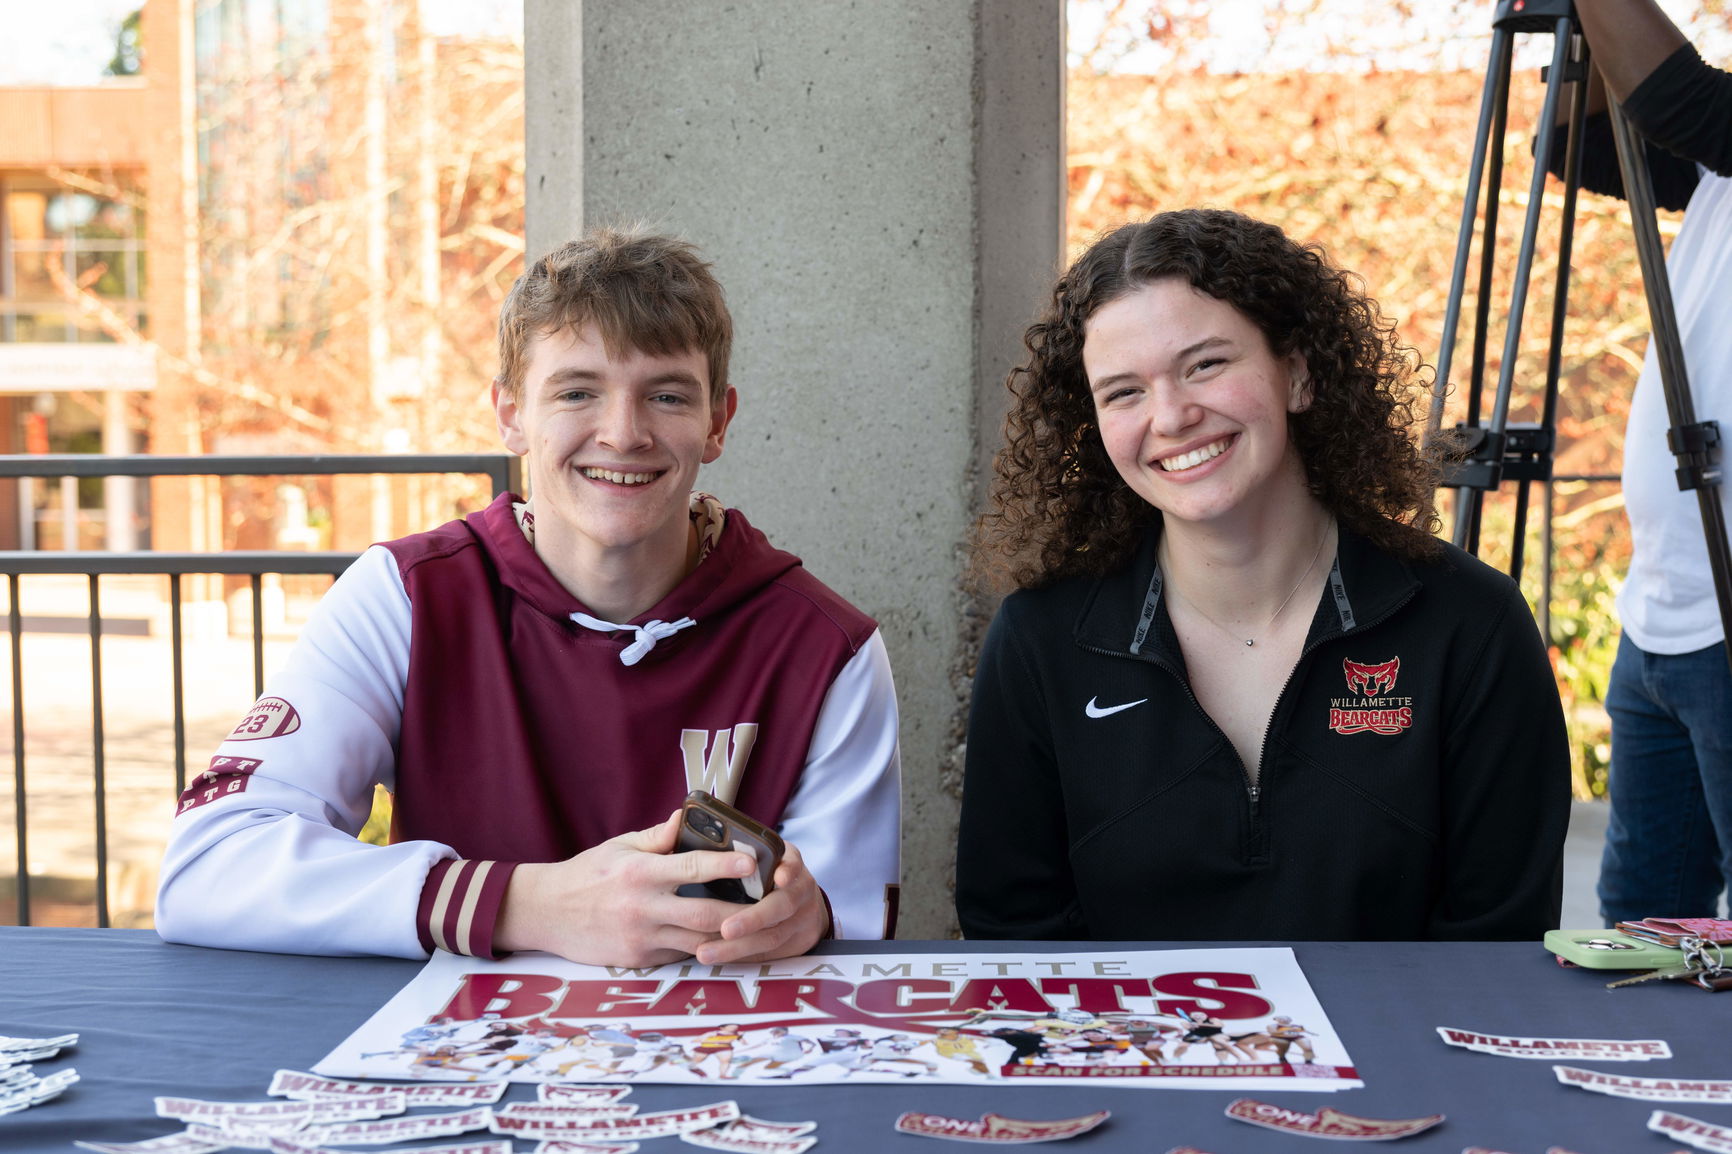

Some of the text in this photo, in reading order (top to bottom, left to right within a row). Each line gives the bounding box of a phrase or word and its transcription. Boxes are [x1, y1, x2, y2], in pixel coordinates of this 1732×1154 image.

[1333, 583, 1346, 601] NIKE
[1143, 601, 1155, 620] NIKE
[1330, 696, 1413, 708] WILLAMETTE
[232, 714, 269, 735] 23
[1328, 706, 1413, 733] BEARCATS
[680, 723, 759, 807] W
[605, 960, 1132, 978] WILLAMETTE
[424, 971, 1274, 1029] BEARCATS
[1444, 1030, 1665, 1056] WILLAMETTE
[1011, 1065, 1284, 1077] SCAN FOR SCHEDULE
[275, 1072, 500, 1099] WILLAMETTE
[1613, 1087, 1732, 1099] SOCCE
[164, 1095, 399, 1116] WILLAMETTE
[495, 1104, 732, 1130] WILLAMETTE
